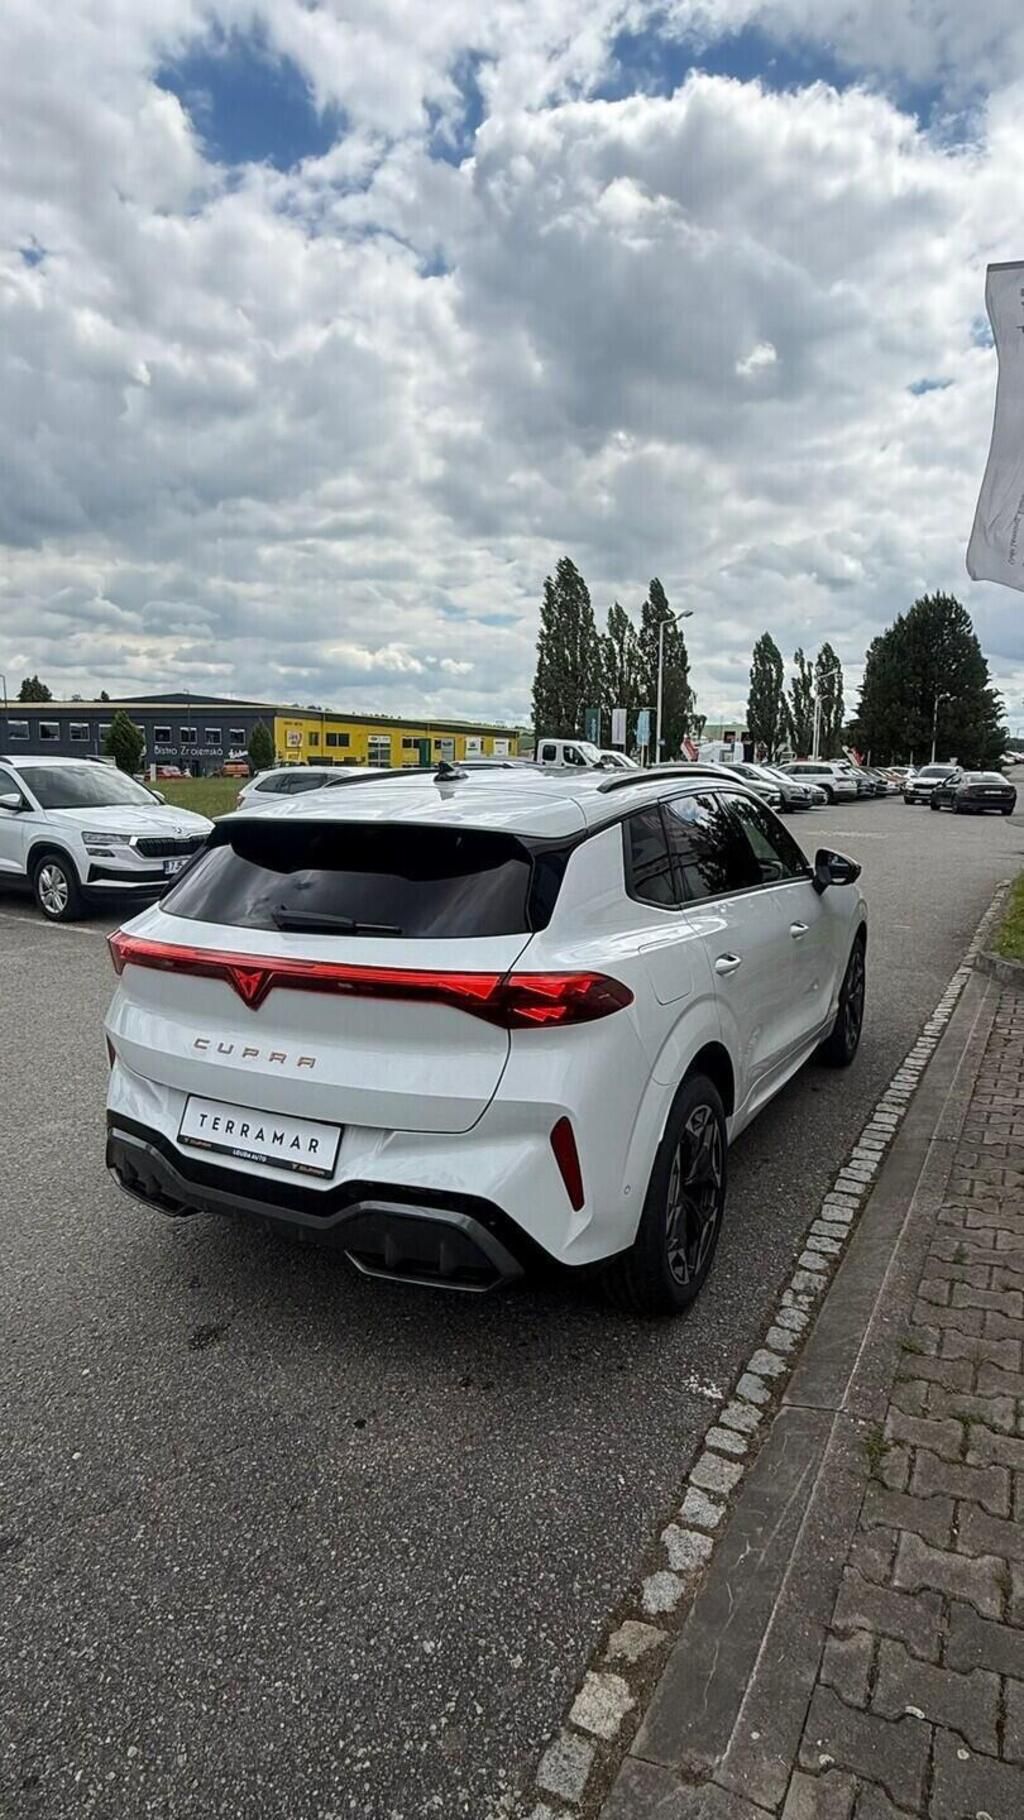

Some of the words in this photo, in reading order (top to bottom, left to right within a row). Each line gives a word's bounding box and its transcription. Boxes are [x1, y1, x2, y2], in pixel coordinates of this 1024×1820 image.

[154, 745, 178, 755] Bistro
[194, 1038, 316, 1068] CUPRA
[200, 1114, 319, 1153] TERRAMAR
[251, 1153, 267, 1162] AUTO
